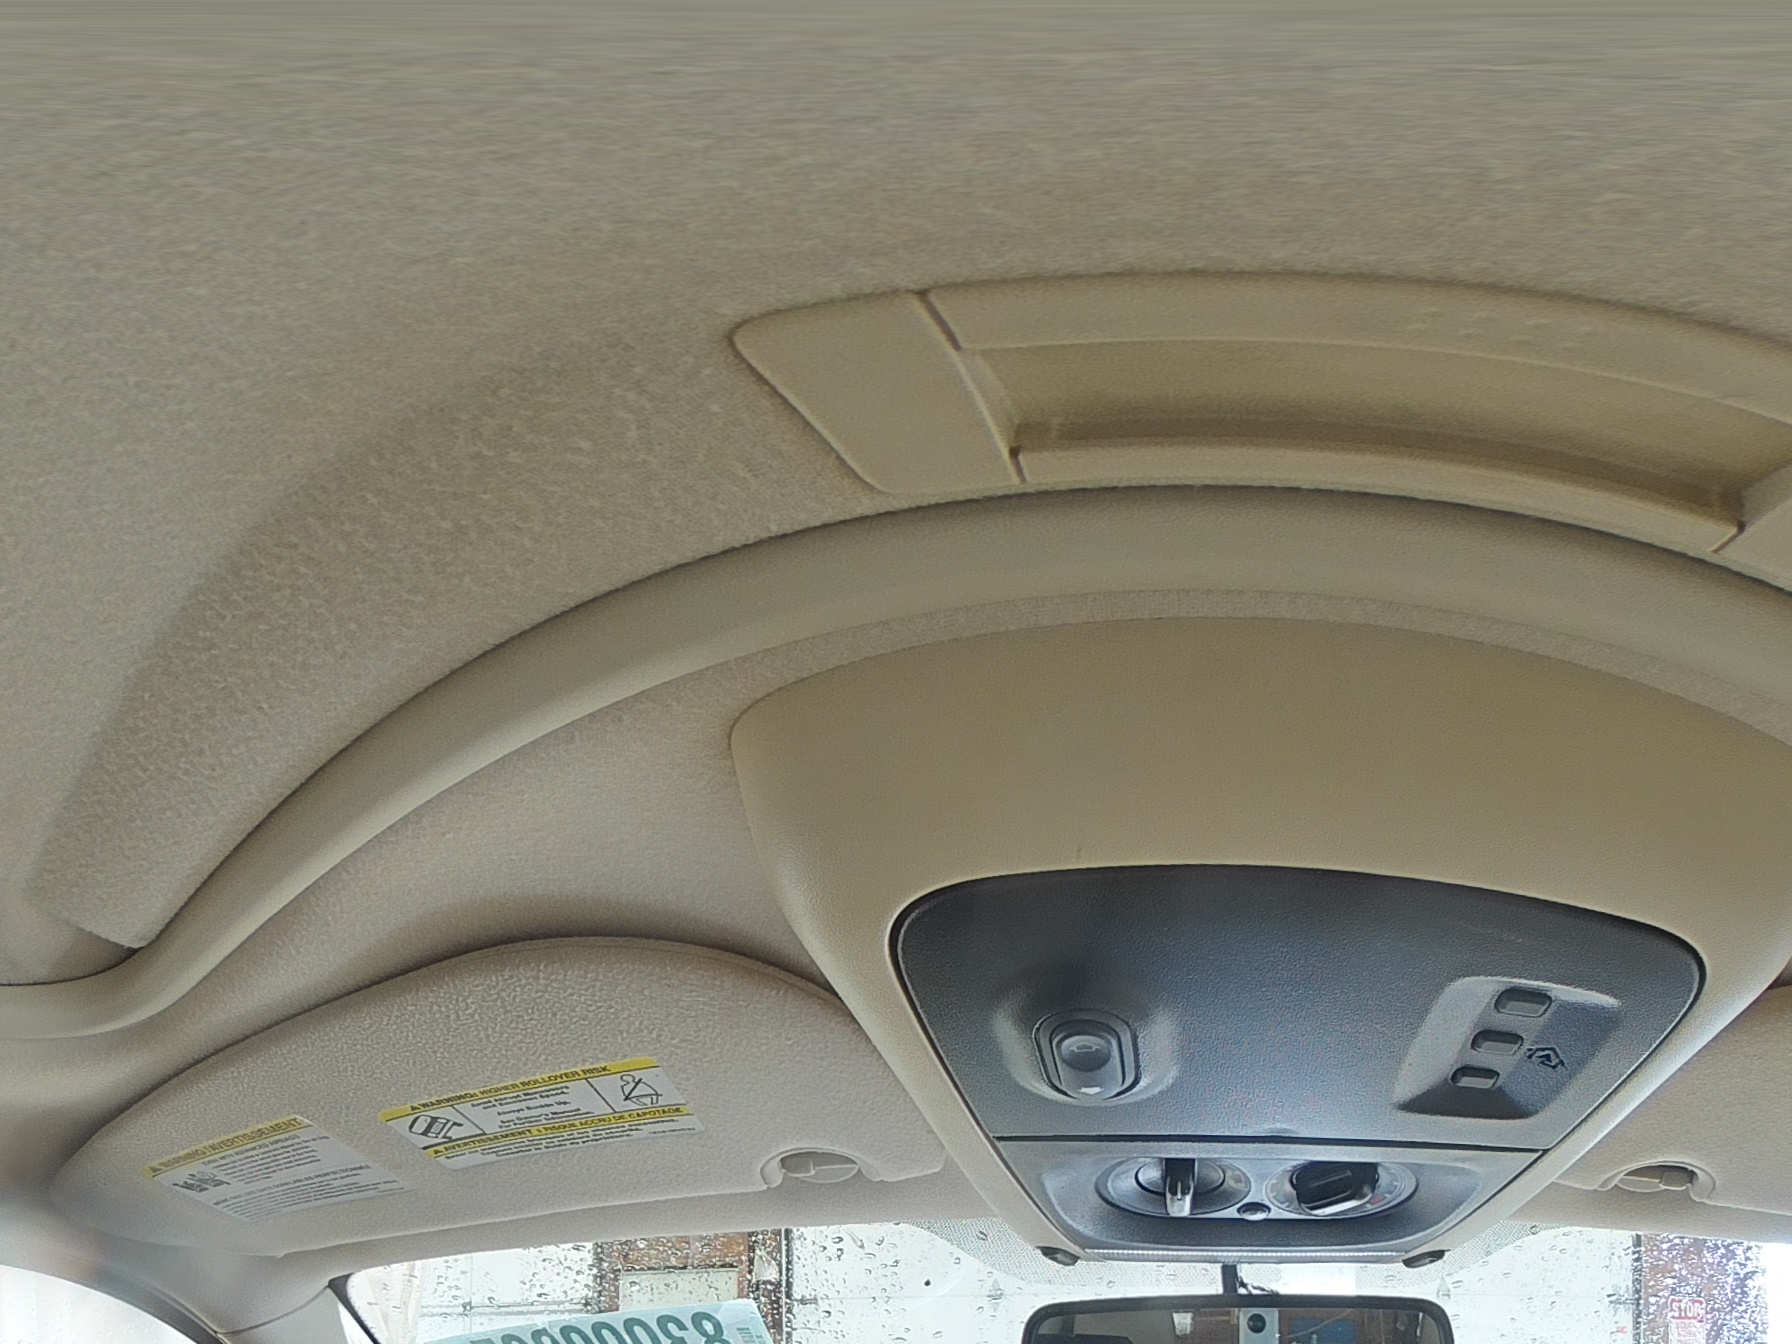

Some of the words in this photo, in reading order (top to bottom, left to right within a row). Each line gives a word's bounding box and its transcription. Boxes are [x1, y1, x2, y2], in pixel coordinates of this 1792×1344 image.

[479, 1082, 520, 1096] HIGHER
[520, 1070, 581, 1088] ROLLOVER
[582, 1065, 611, 1076] RISK
[444, 1129, 533, 1151] AVERTISSEMENT
[544, 1121, 578, 1132] RISQUE
[628, 1107, 684, 1119] CAPOTAGE
